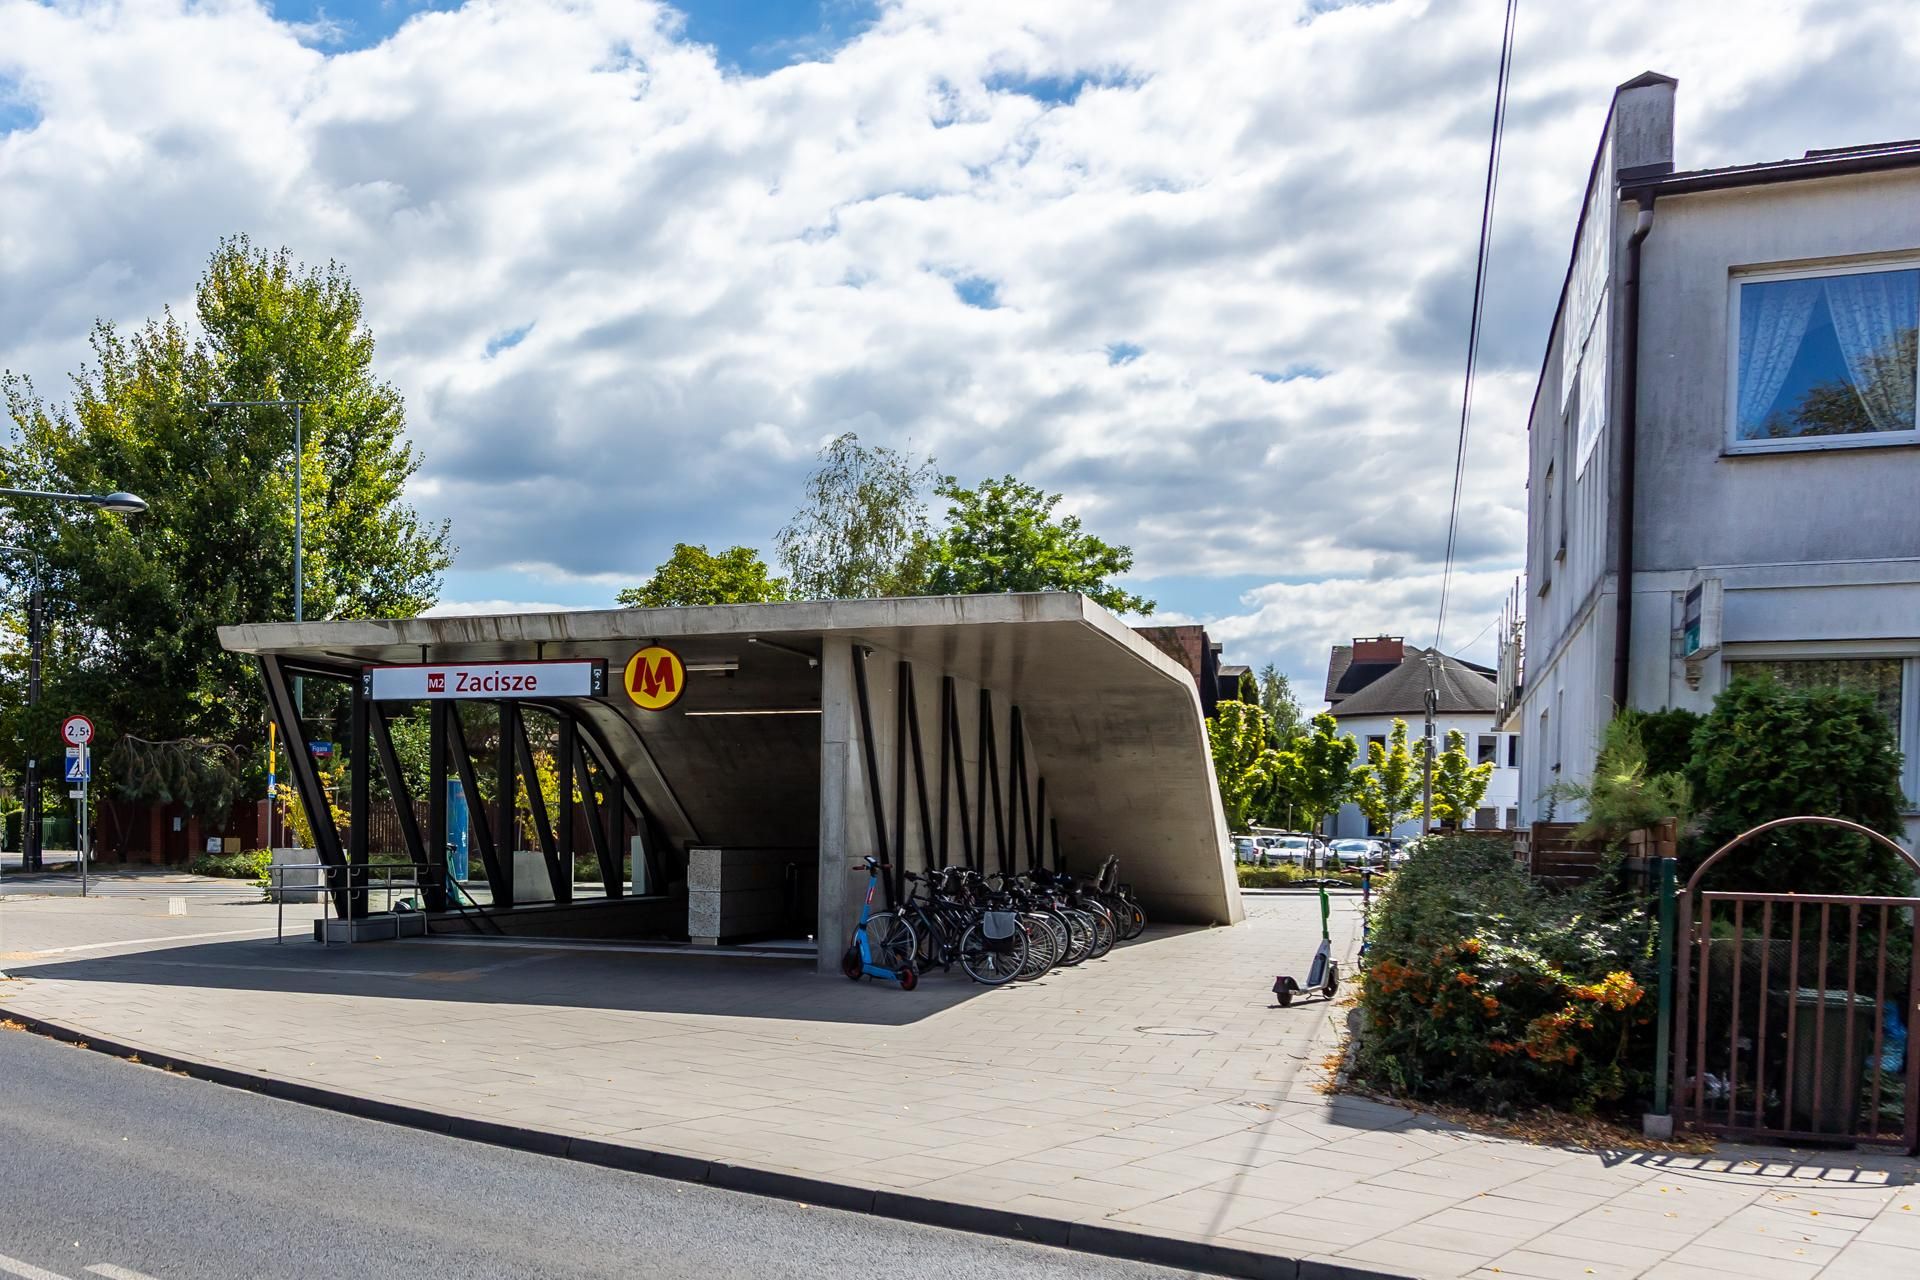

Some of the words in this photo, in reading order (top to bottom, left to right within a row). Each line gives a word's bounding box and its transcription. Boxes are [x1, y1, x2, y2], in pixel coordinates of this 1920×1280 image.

[428, 678, 445, 689] M2
[455, 671, 537, 692] Zacisze
[631, 657, 676, 698] M
[364, 686, 370, 695] 2
[594, 681, 601, 690] 2
